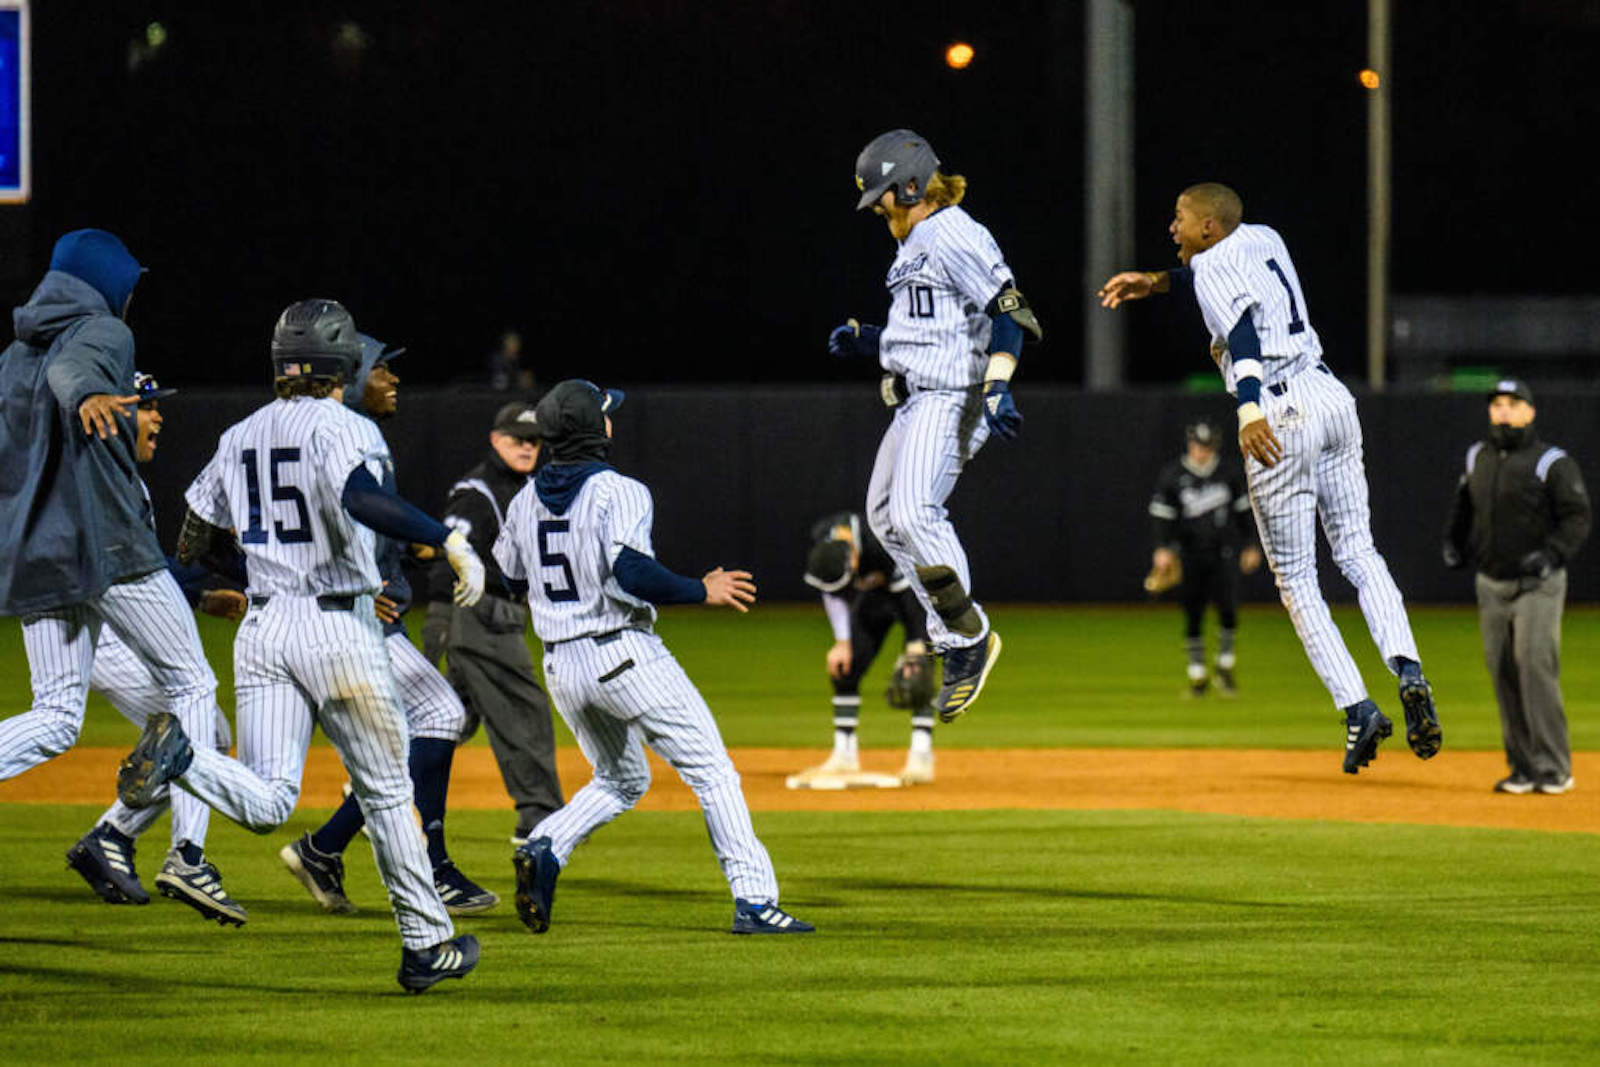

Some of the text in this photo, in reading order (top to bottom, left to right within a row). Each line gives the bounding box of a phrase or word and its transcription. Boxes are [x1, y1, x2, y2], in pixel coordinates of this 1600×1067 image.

[908, 286, 934, 318] 10
[1266, 258, 1304, 335] 1
[242, 448, 313, 544] 15
[538, 520, 580, 602] 5
